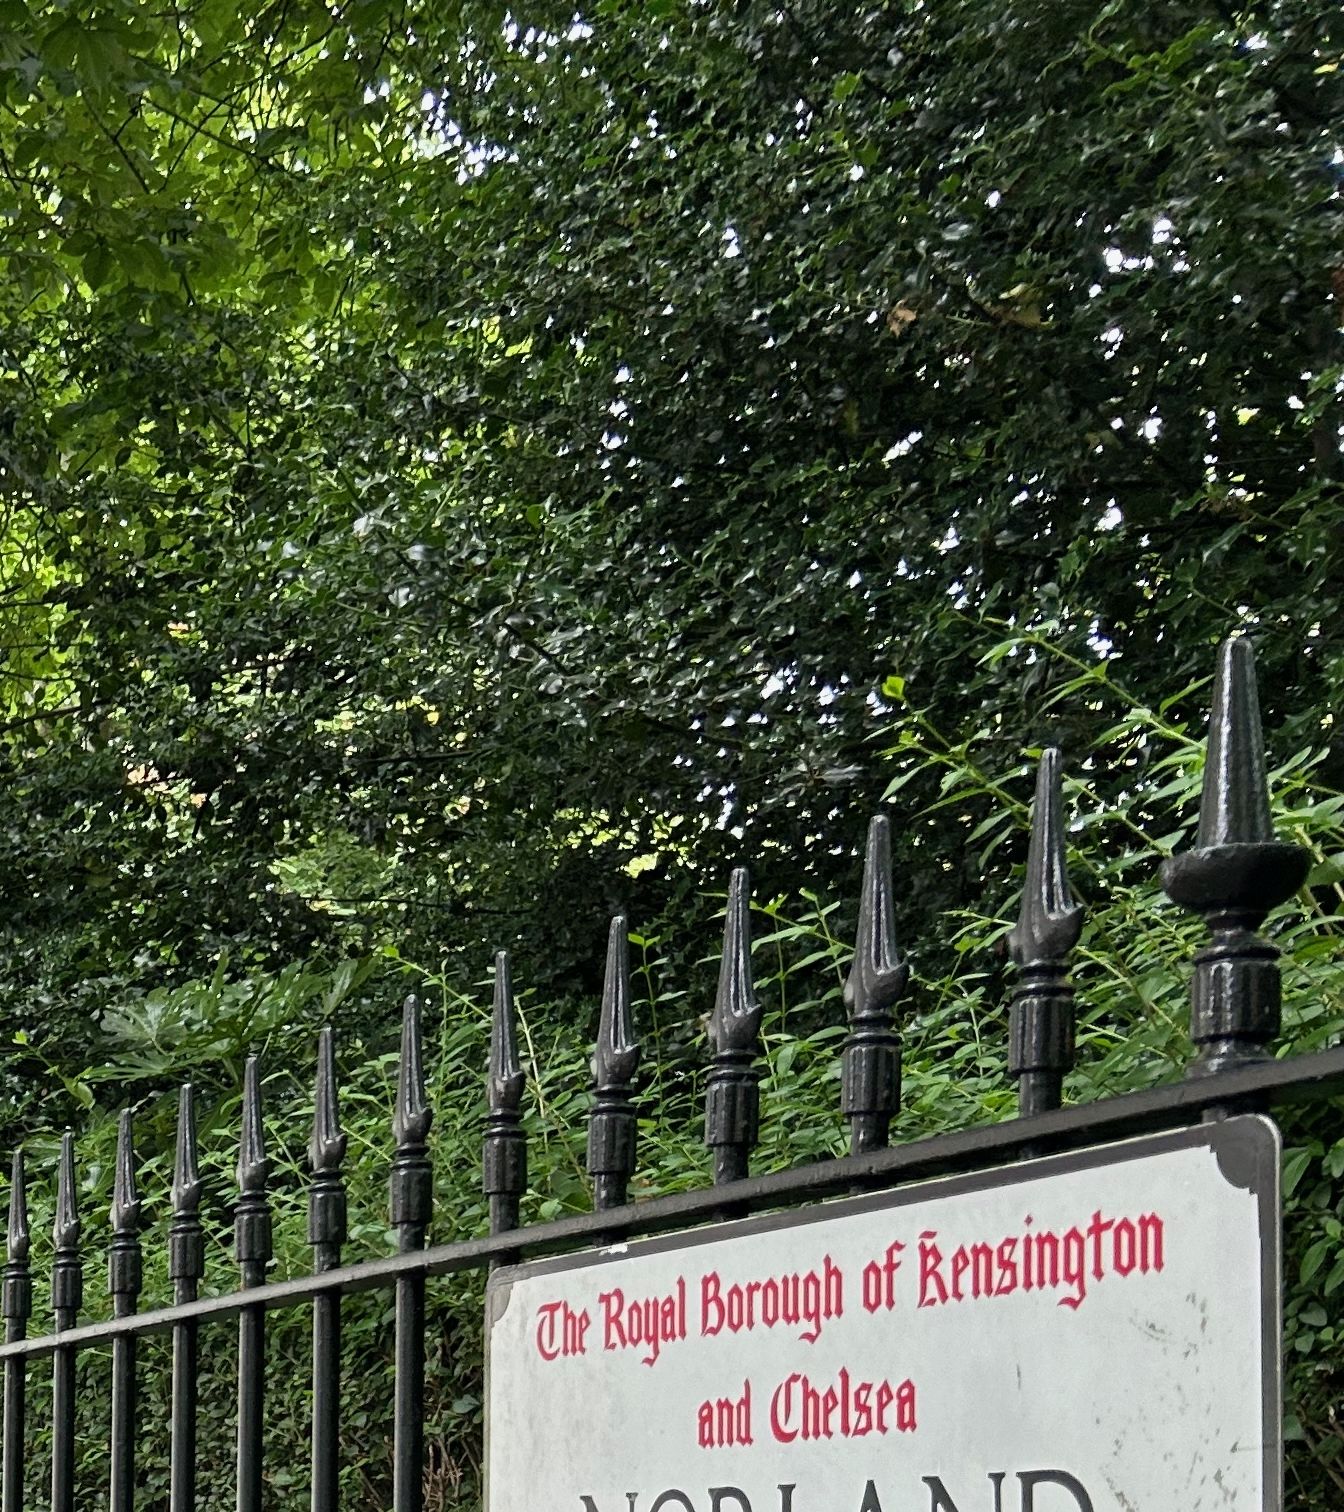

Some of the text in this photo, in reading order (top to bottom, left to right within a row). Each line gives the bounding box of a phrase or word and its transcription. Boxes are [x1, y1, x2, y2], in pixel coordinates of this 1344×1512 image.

[535, 1210, 1165, 1368] The Royal Borough of Kensington
[697, 1368, 918, 1449] and Chelsea
